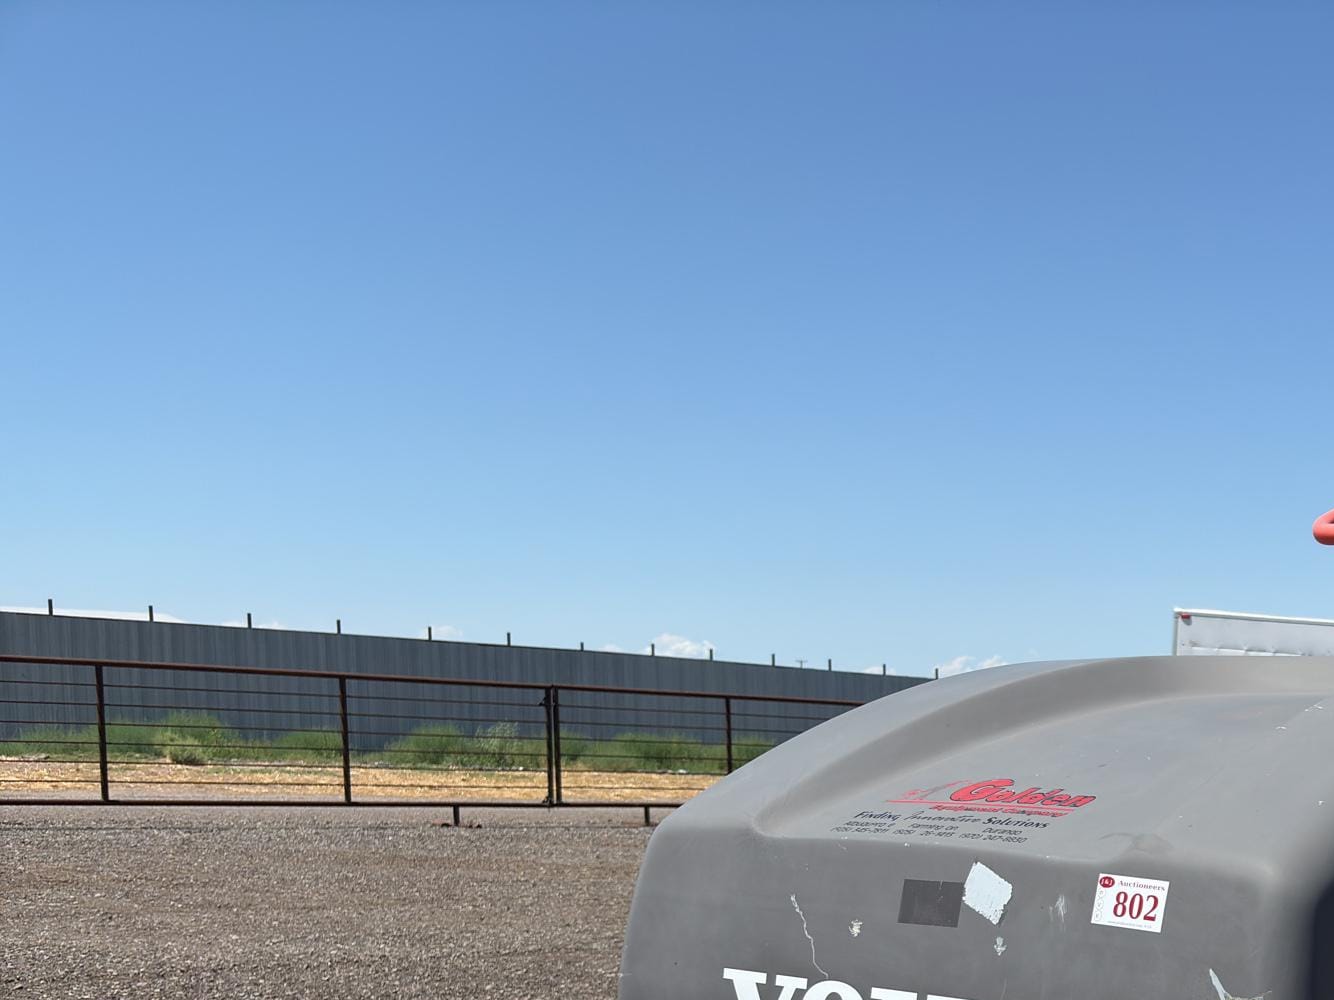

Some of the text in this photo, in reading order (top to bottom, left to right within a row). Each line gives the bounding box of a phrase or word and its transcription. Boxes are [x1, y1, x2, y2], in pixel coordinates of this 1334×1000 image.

[949, 778, 1096, 808] Golden
[853, 810, 901, 821] Finding
[982, 816, 1050, 829] Solutions
[1118, 880, 1165, 891] Auctioneers
[1113, 891, 1159, 921] 802
